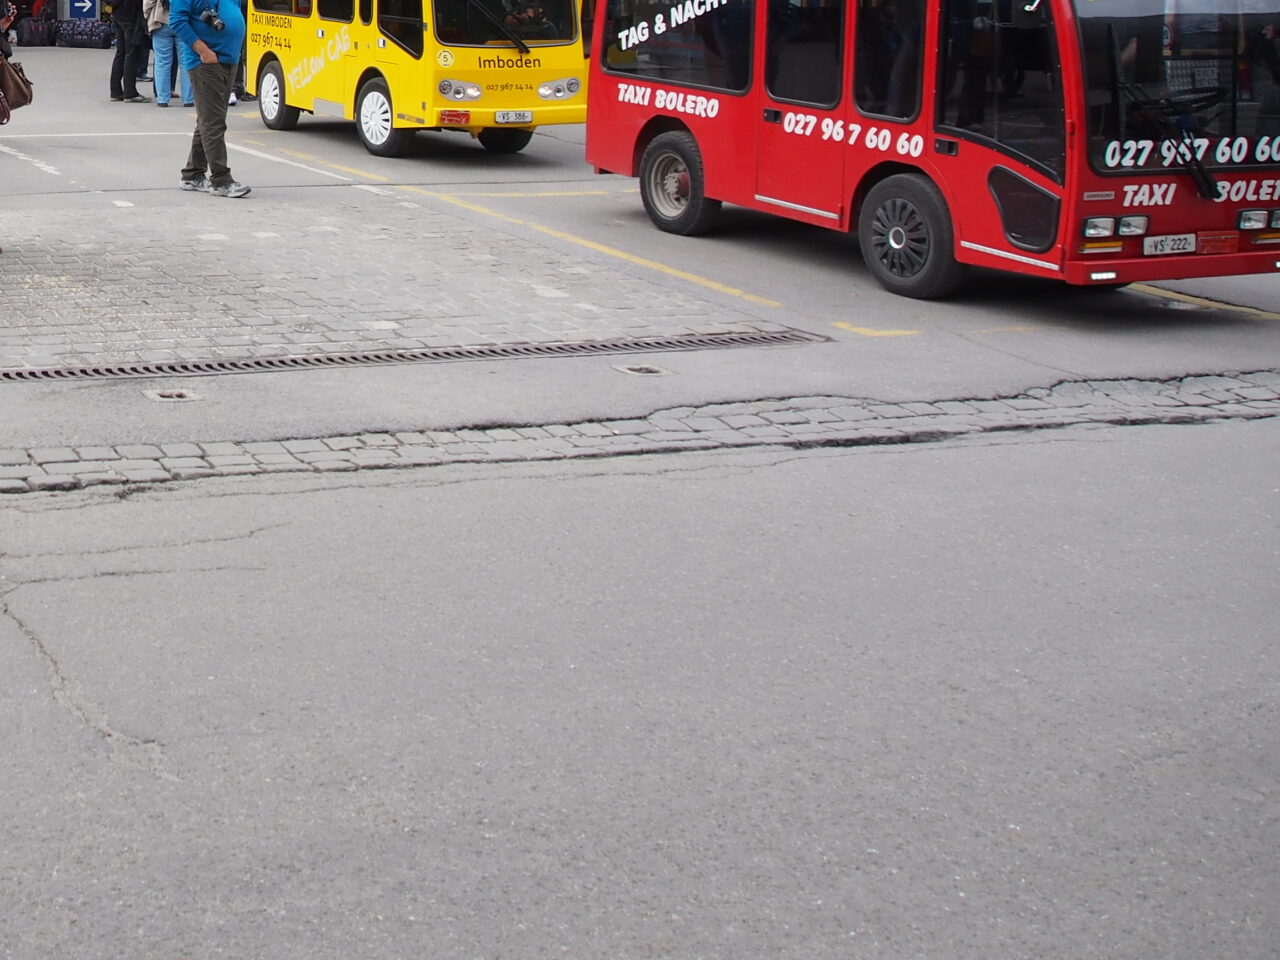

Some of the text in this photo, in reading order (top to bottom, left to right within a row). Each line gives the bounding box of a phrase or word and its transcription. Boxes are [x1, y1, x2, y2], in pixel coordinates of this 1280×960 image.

[252, 14, 292, 29] TAXI IMBODEN
[618, 21, 649, 51] TAG
[654, 14, 666, 35] &
[251, 32, 291, 51] 027 967 14 14
[288, 25, 351, 94] YELLOW CAB
[478, 55, 541, 68] Imboden
[500, 83, 513, 91] 967
[618, 83, 719, 118] TAXI BOLERO
[783, 112, 817, 137] 027
[865, 126, 891, 151] 60
[896, 131, 924, 158] 60
[1105, 140, 1153, 167] 027
[1215, 137, 1248, 163] 60
[1123, 183, 1177, 207] TAXI
[1170, 237, 1188, 250] 222
